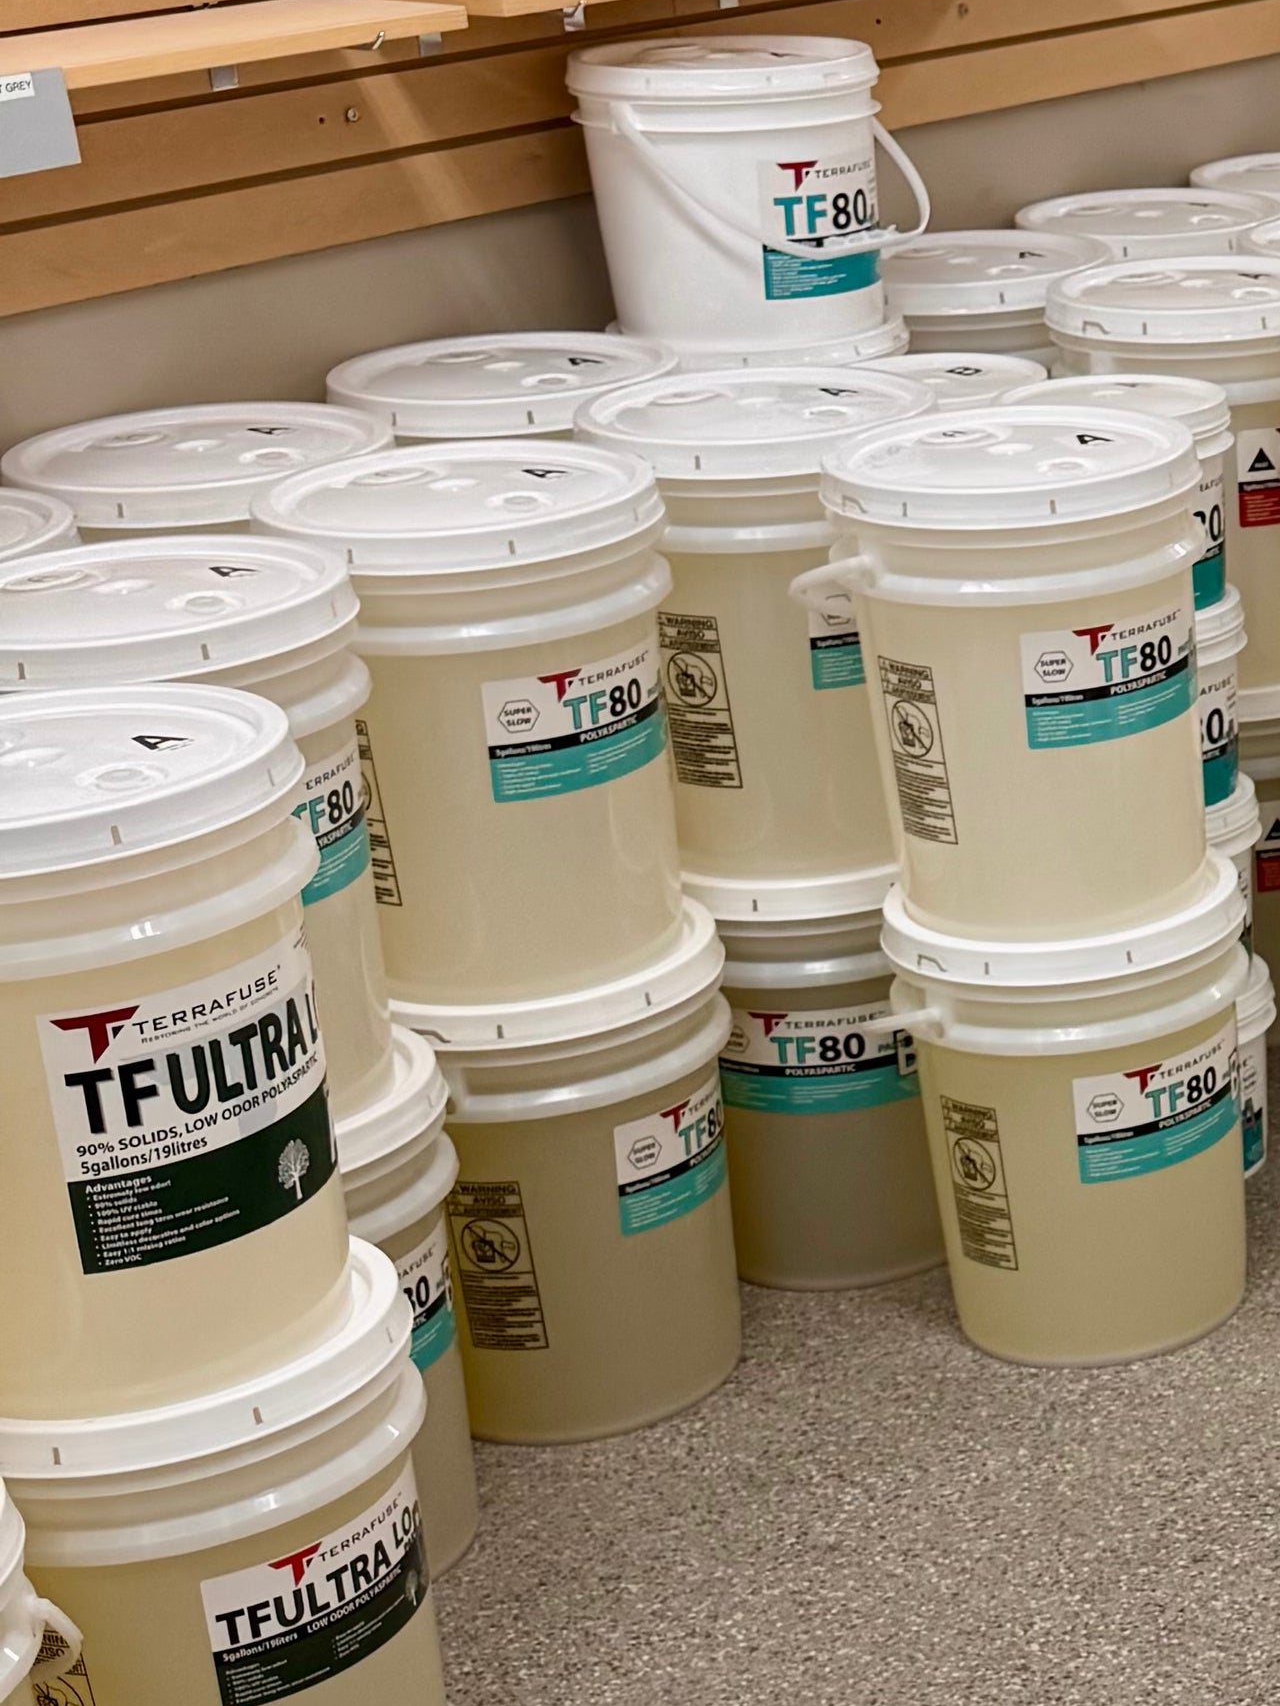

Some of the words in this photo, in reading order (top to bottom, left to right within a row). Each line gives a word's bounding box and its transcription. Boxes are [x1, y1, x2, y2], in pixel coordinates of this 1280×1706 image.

[774, 189, 867, 236] TF80
[1098, 636, 1172, 684] TF80
[563, 678, 642, 730] TF80
[132, 970, 278, 1035] TERRAFUSE
[769, 1032, 866, 1064] TF80
[1146, 1066, 1218, 1118] TF80
[76, 1140, 114, 1158] 90%
[119, 1126, 183, 1150] SOLIDS,
[185, 1113, 219, 1134] LOW
[221, 1095, 261, 1120] ODOR
[81, 1136, 208, 1175] 5gallons/19litres
[85, 1175, 152, 1194] Advantages
[319, 1499, 398, 1562] TERRAFUSE
[306, 1619, 329, 1634] LOW
[330, 1602, 355, 1622] ODOR
